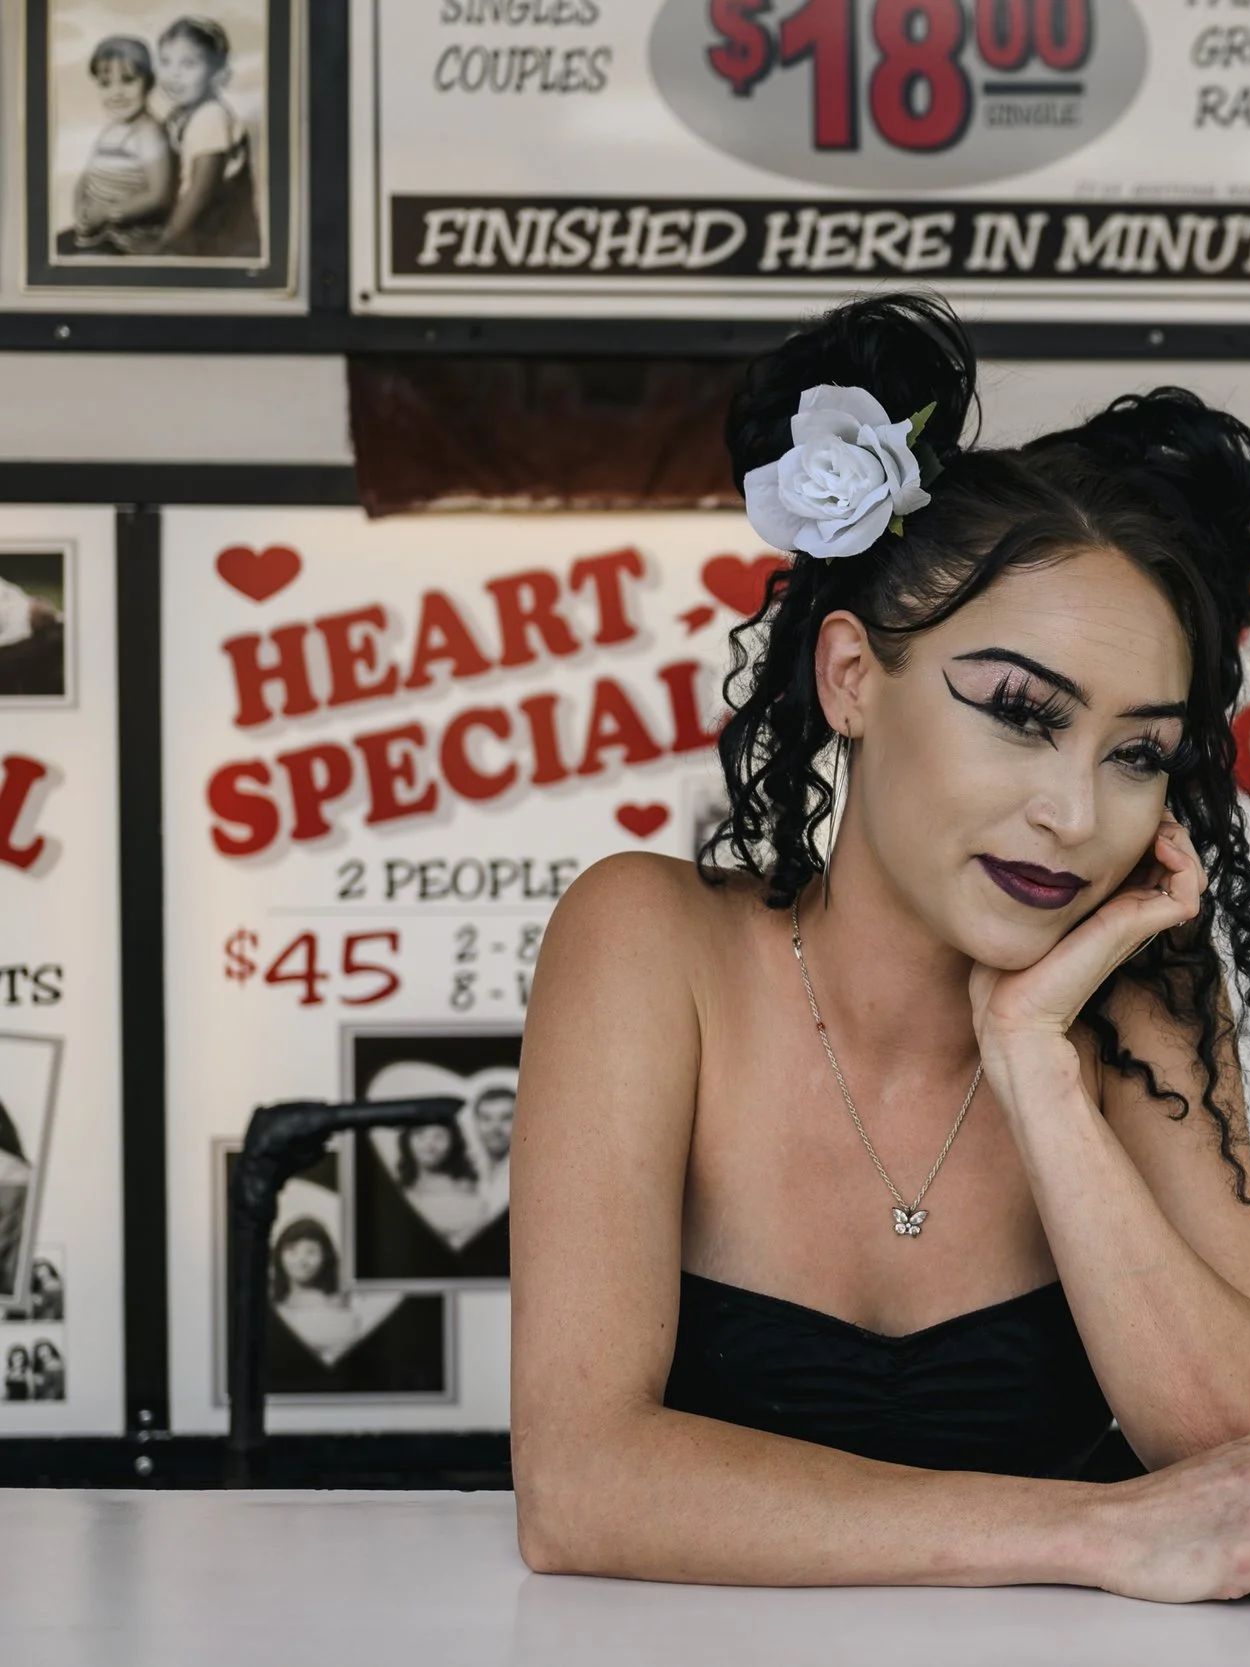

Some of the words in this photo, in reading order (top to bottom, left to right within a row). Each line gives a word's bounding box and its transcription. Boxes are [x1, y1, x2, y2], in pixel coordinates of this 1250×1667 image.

[432, 45, 614, 94] COUPLES
[415, 205, 747, 271] FINISHED
[757, 207, 956, 273] HERE
[963, 211, 1050, 274] IN
[220, 545, 648, 731] HEART
[205, 660, 734, 860] SPECIAL
[336, 859, 366, 901] 2
[384, 857, 580, 902] PEOPLE
[222, 925, 402, 1007] $45
[453, 922, 480, 964] 2
[449, 969, 478, 1014] 8
